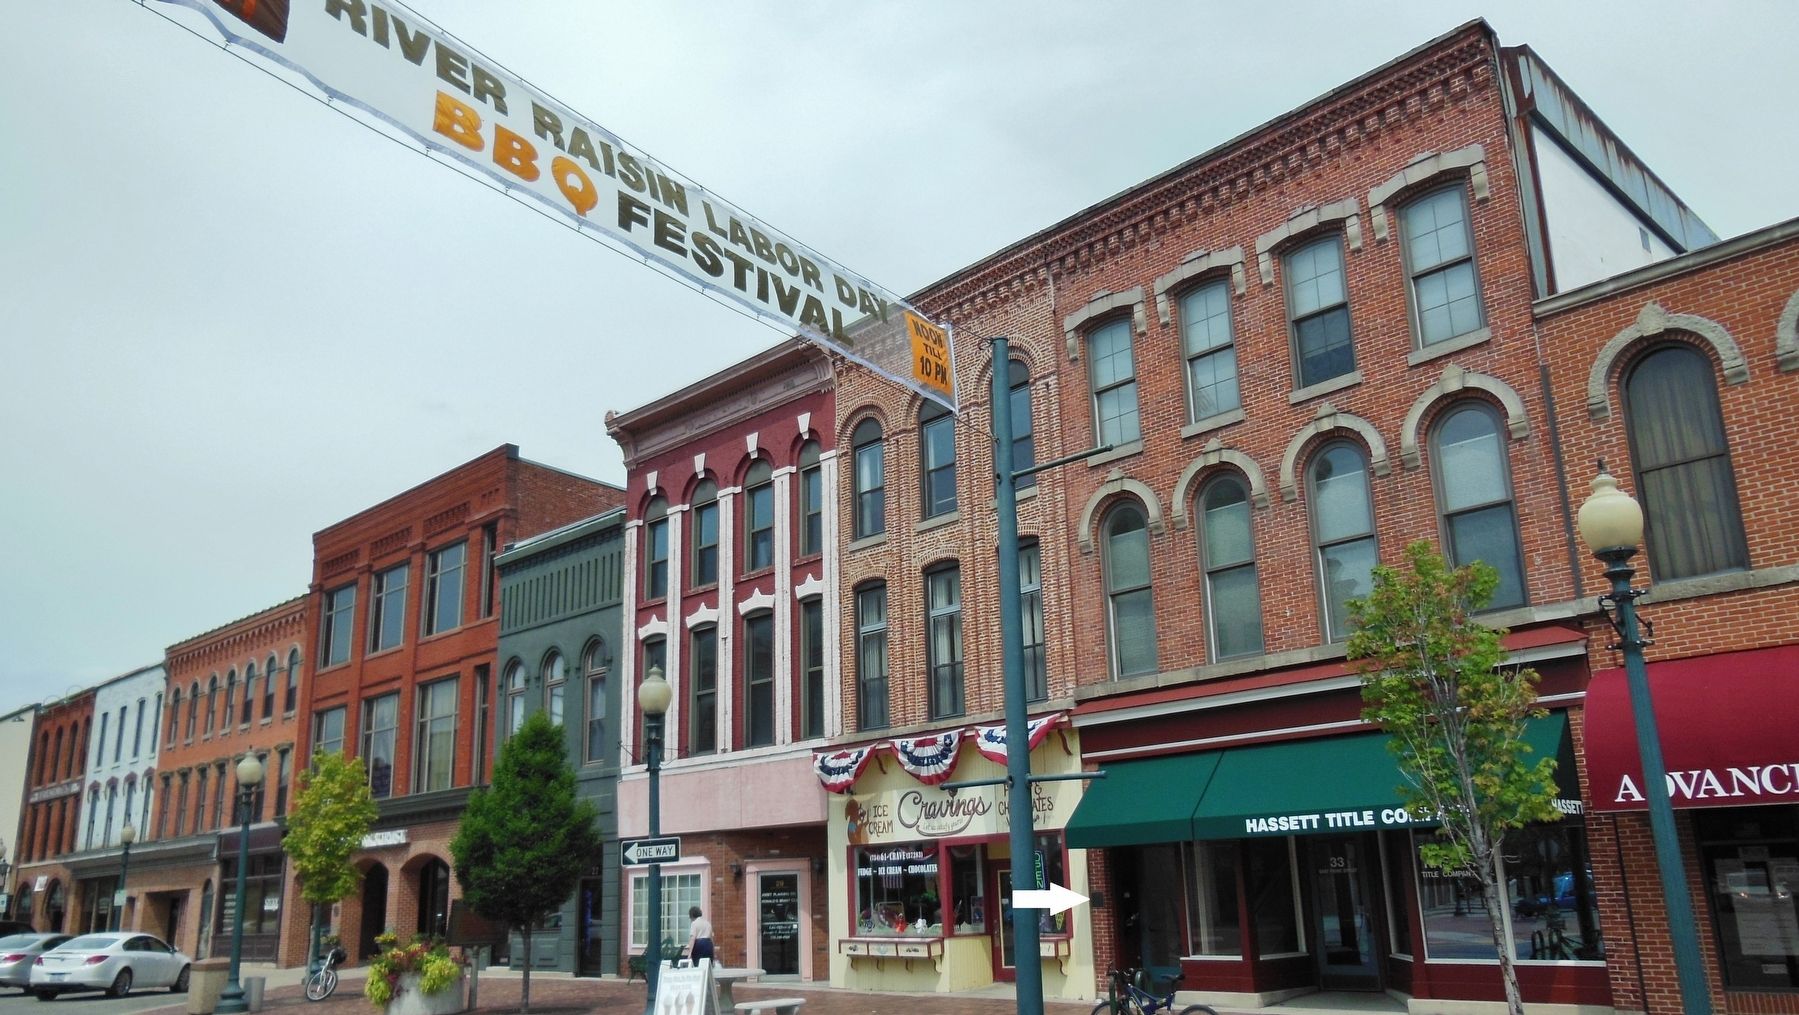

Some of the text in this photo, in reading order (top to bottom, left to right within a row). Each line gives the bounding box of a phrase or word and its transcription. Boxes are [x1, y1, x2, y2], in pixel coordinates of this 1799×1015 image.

[325, 0, 889, 324] RIVER RAISIN LABOR DAY
[433, 90, 854, 347] BBQ FESTIVAL
[912, 319, 943, 348] NOON
[923, 343, 942, 360] TILL
[920, 355, 947, 385] 10 PM
[873, 805, 889, 818] ICE
[897, 790, 993, 837] Cravings
[1246, 814, 1320, 833] HASSETT
[1325, 810, 1375, 828] TITLE
[868, 820, 894, 837] CREAM
[636, 845, 674, 858] ONE WAY
[886, 865, 902, 875] CREAM
[907, 863, 938, 874] CHOCOLATES
[1330, 856, 1345, 868] 33
